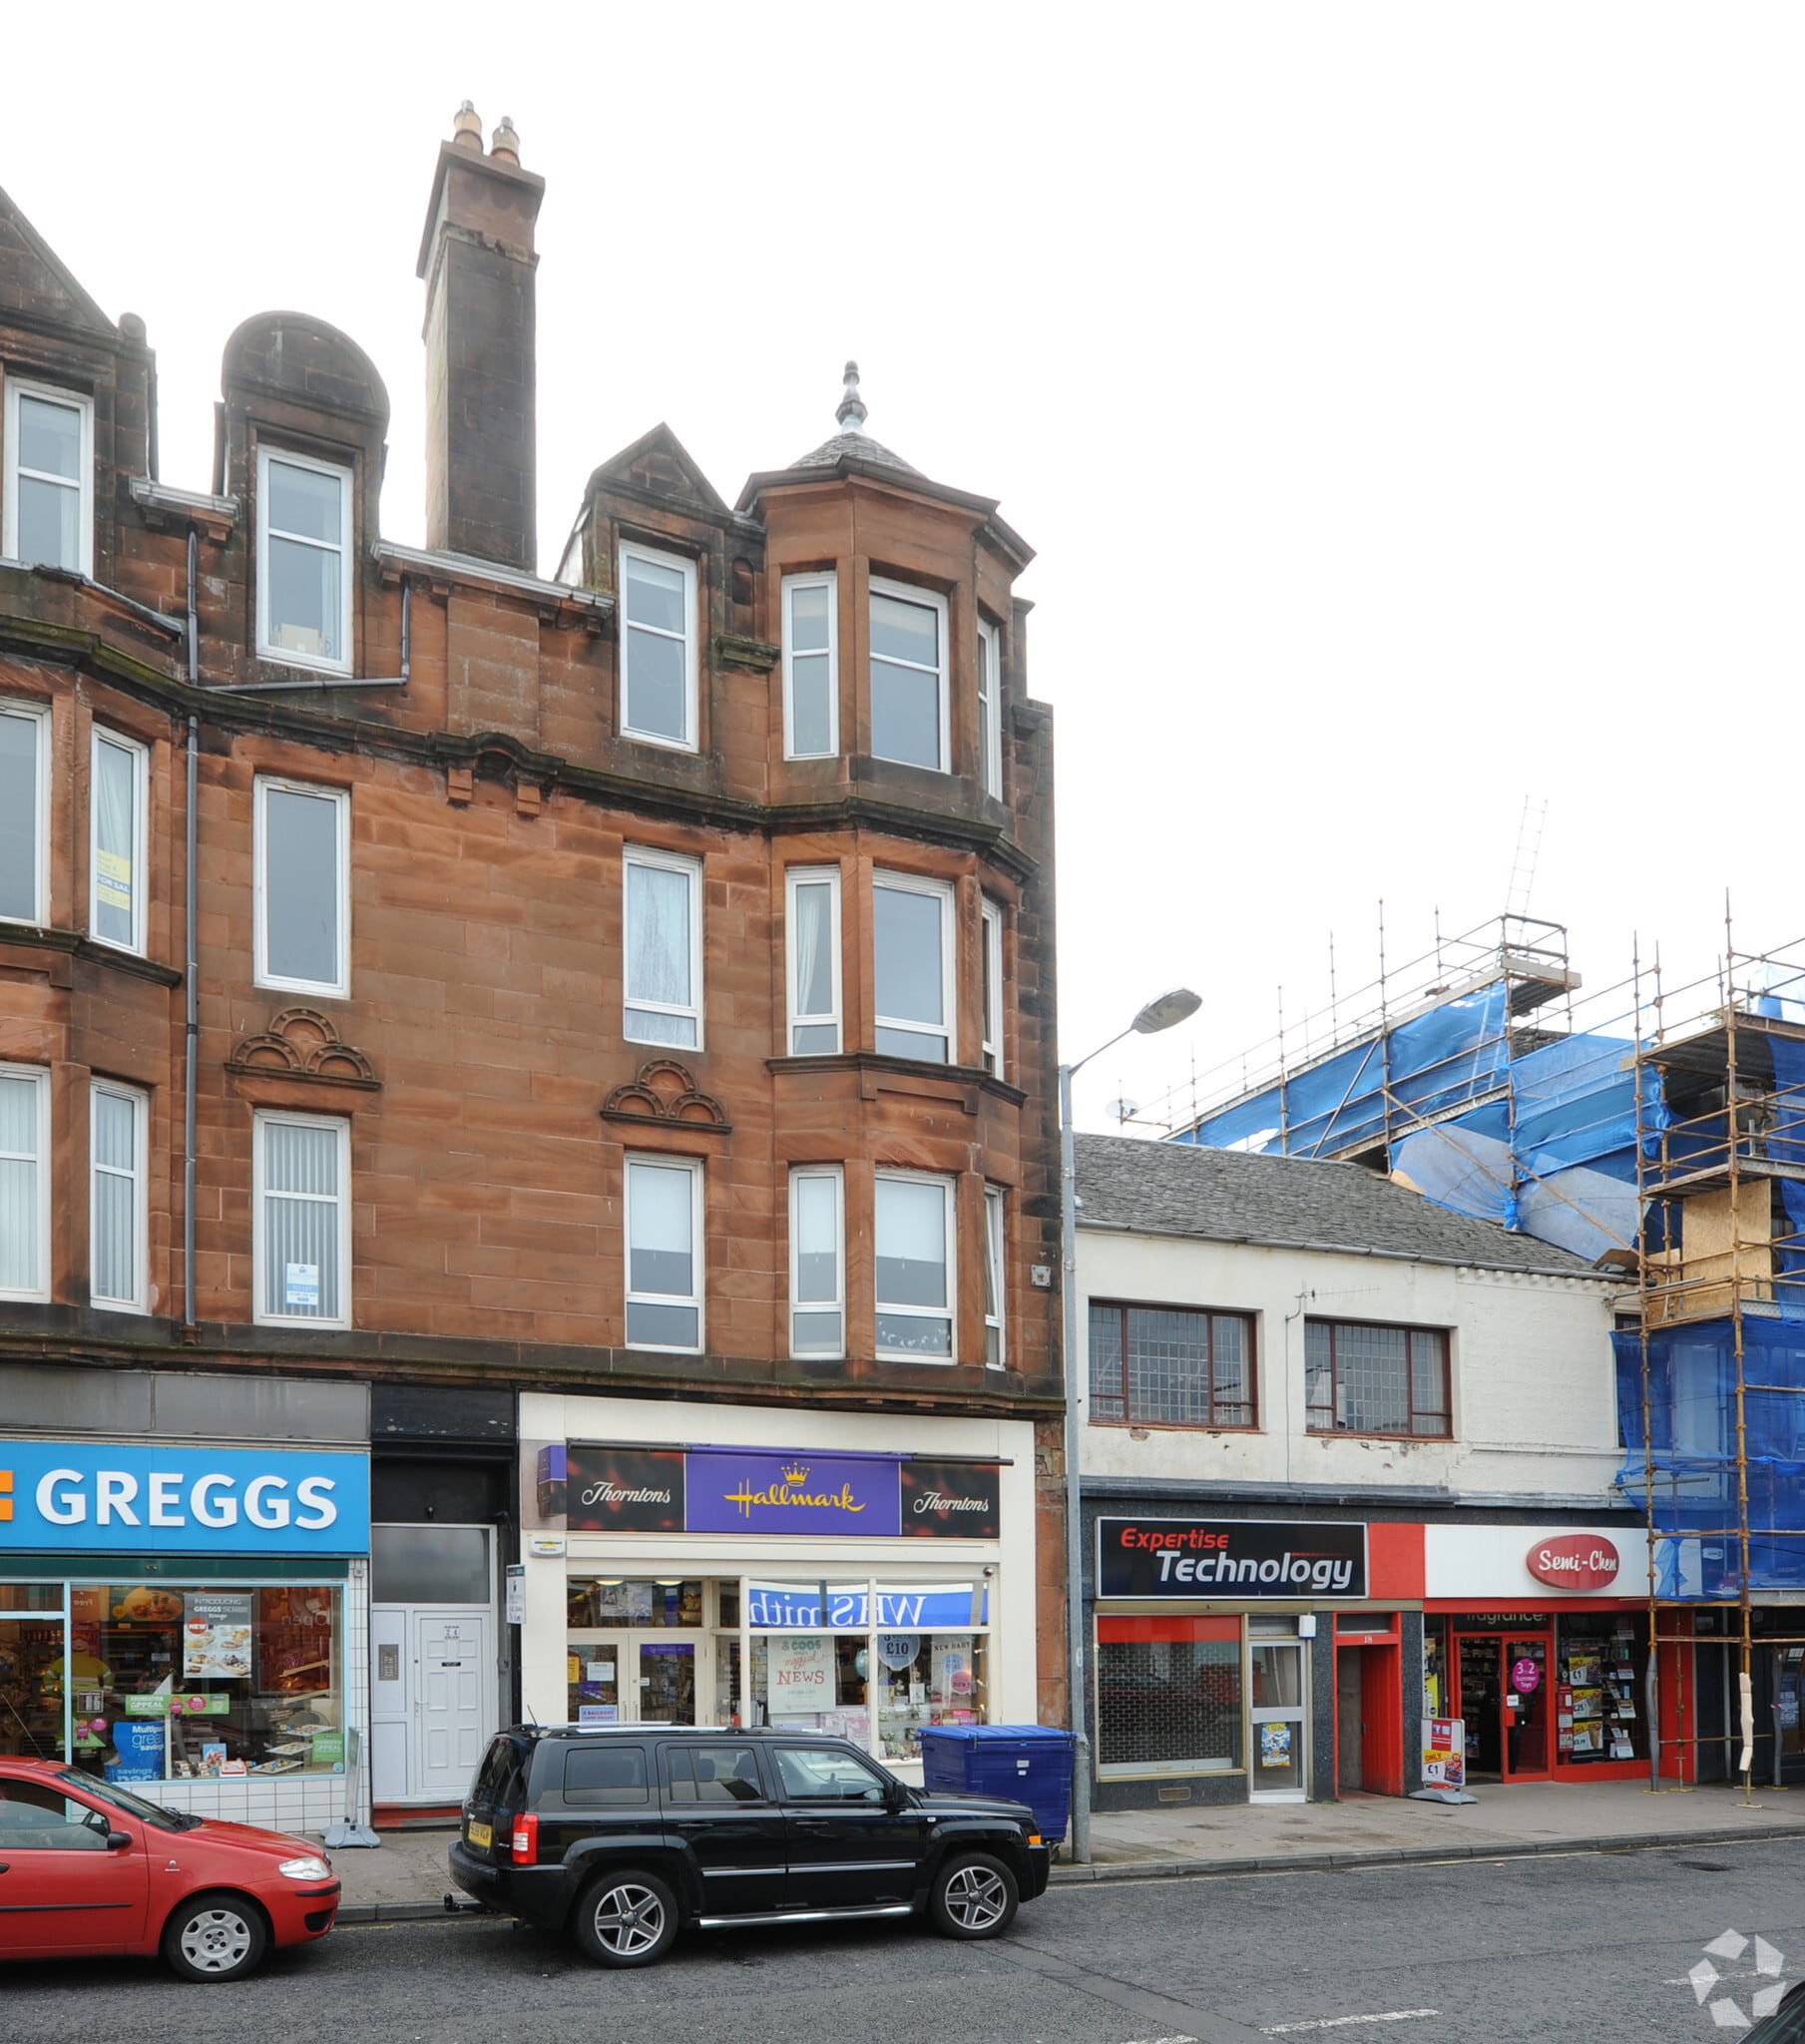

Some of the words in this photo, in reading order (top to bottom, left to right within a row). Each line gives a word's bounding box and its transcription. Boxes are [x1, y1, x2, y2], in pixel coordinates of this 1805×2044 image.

[36, 1469, 337, 1530] GREGGS
[581, 1481, 671, 1506] Thorntons
[723, 1478, 866, 1518] Hallmark
[913, 1491, 990, 1514] Thorntons
[1121, 1527, 1229, 1552] Expertise
[1155, 1550, 1354, 1590] Technology
[1539, 1550, 1617, 1572] Semi-Chem
[886, 1642, 909, 1655] £10
[776, 1670, 824, 1686] NEWS
[1425, 1754, 1442, 1763] ONLY
[1428, 1765, 1439, 1775] £1
